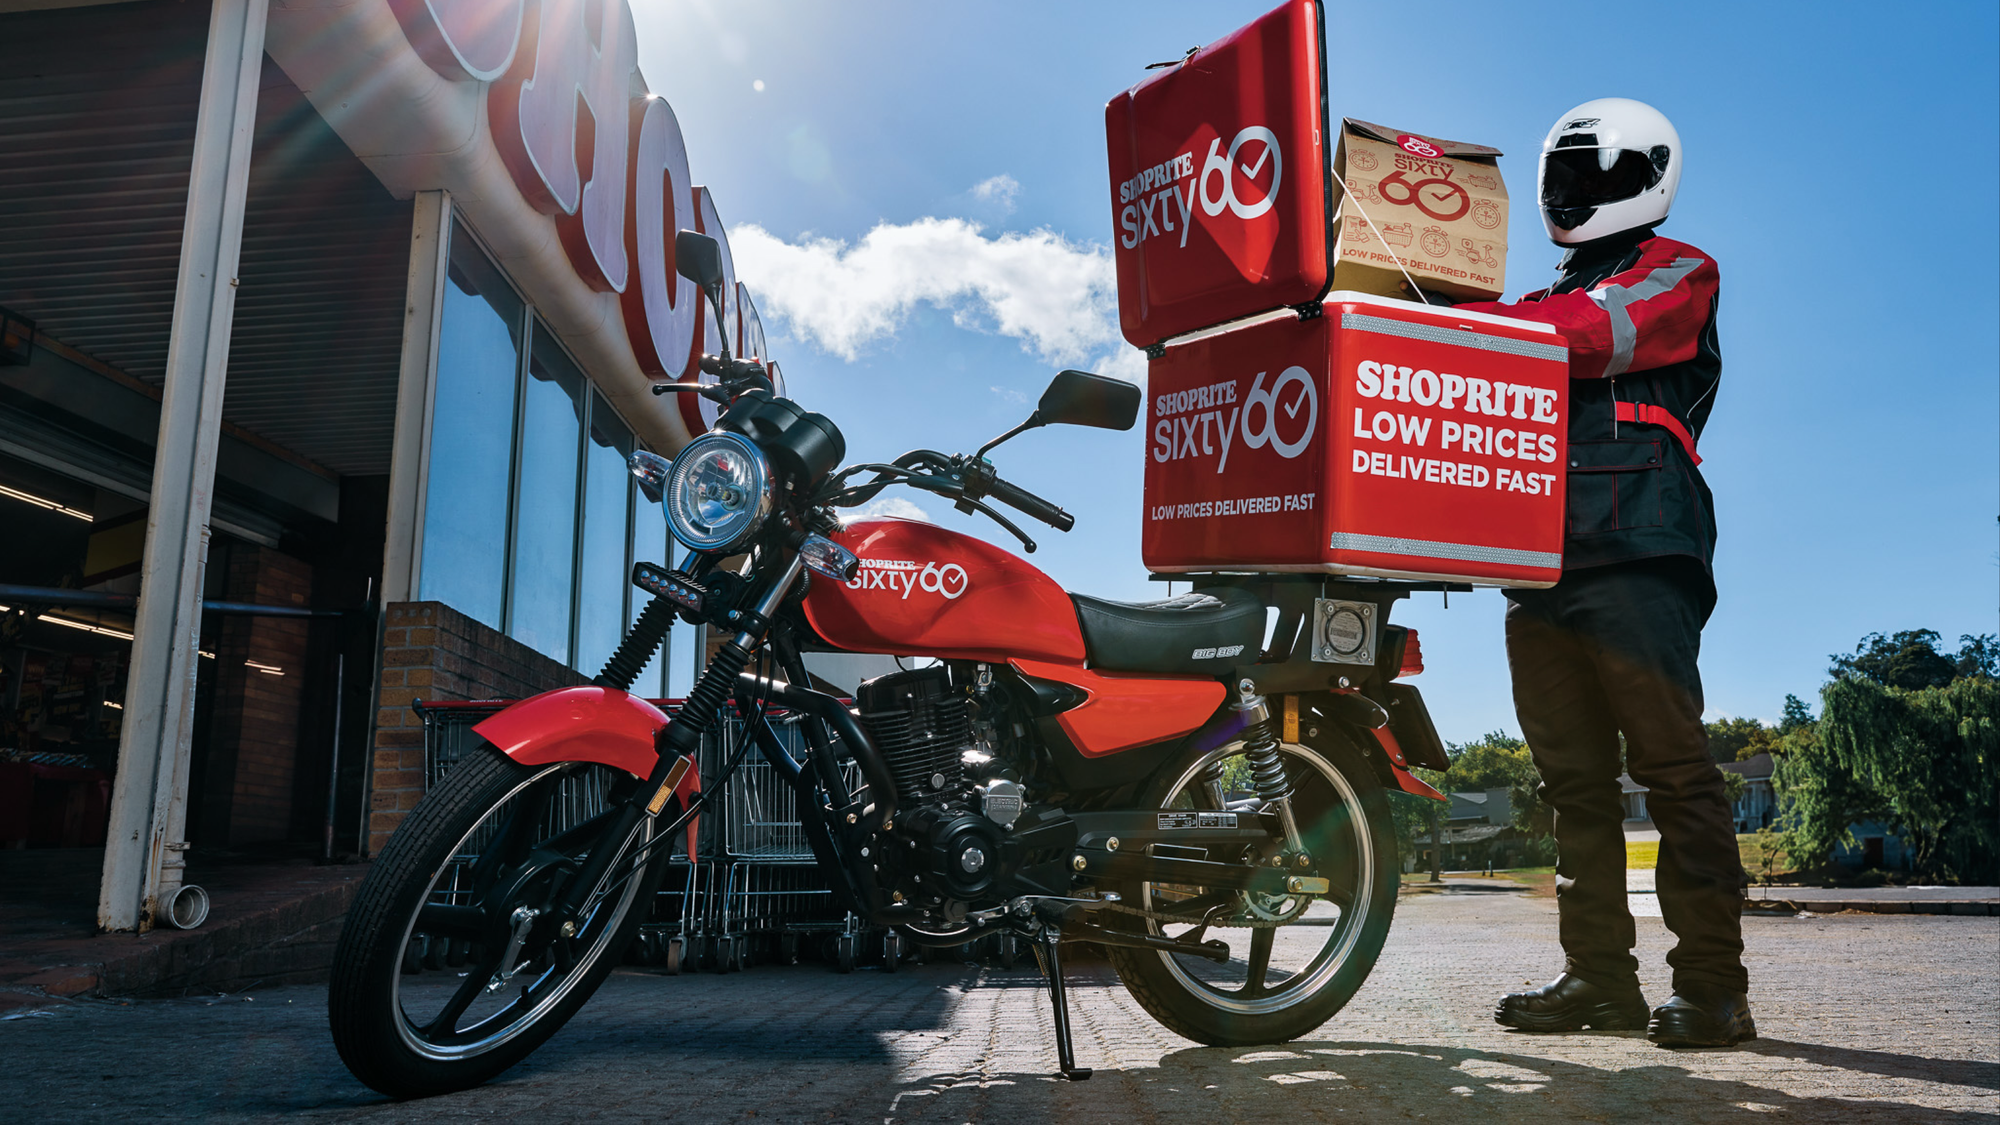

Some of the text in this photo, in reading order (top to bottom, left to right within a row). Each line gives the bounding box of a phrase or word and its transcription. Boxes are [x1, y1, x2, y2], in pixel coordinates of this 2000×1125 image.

[1120, 151, 1194, 204] SHOPRITE
[1394, 152, 1454, 168] SHOPRITE
[1378, 170, 1471, 222] 60
[1342, 248, 1368, 258] LOW
[1410, 259, 1467, 278] DELIVERED
[1470, 273, 1496, 285] FAST
[1156, 379, 1237, 417] SHOPRITE
[1356, 360, 1558, 425] SHOPRITE
[1353, 407, 1557, 463] LOW PRICES
[1352, 449, 1556, 496] DELIVERED FAST
[1152, 493, 1315, 520] LOW PRICES DELIVERED FAST
[858, 558, 916, 571] HOPRITE
[1191, 644, 1245, 660] BIG BOY
